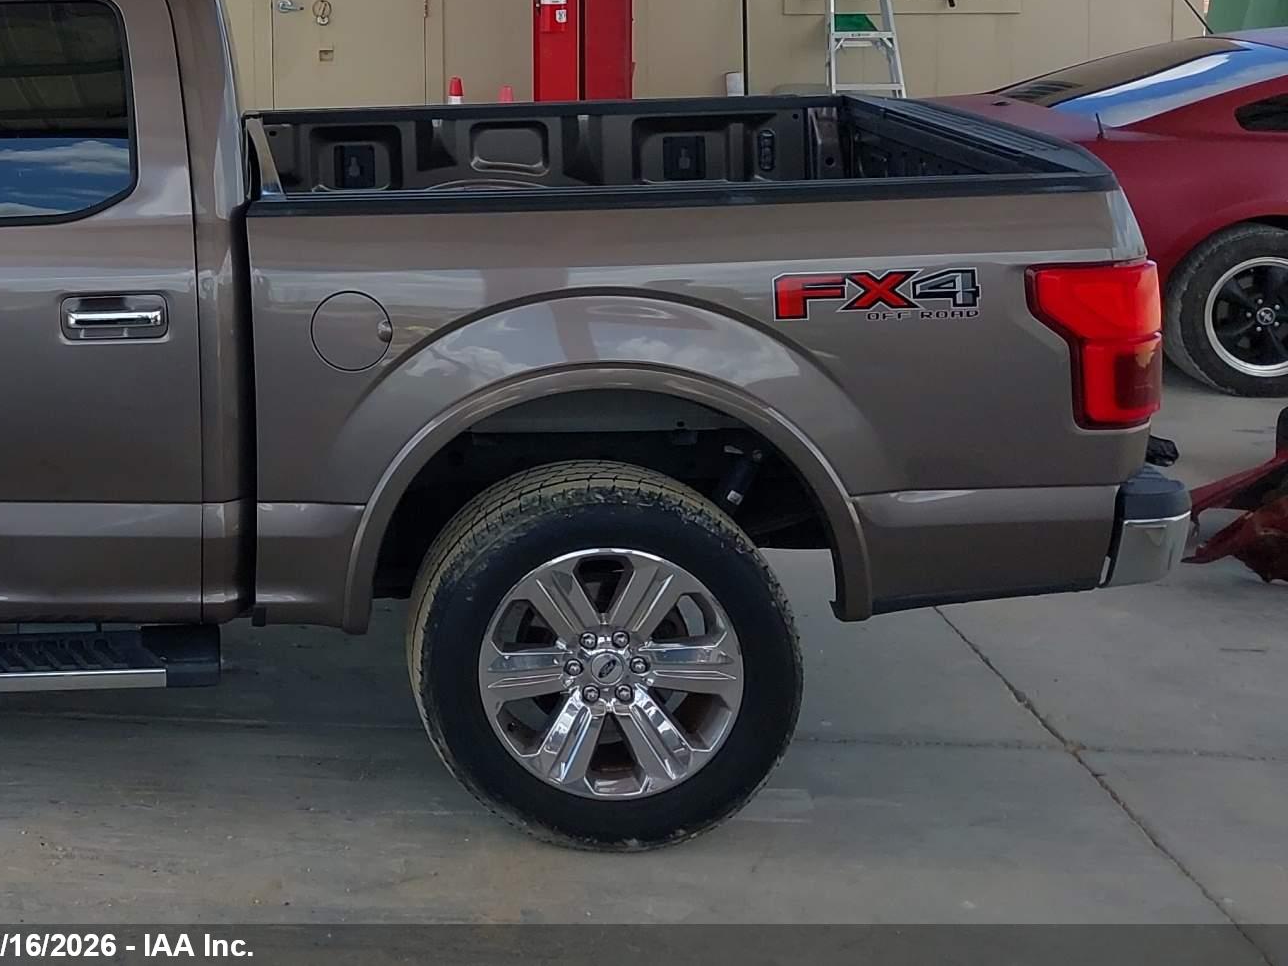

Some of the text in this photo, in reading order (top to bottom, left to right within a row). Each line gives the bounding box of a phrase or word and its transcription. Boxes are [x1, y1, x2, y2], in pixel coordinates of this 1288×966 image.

[773, 267, 982, 321] FX4
[866, 309, 980, 321] OFF ROAD
